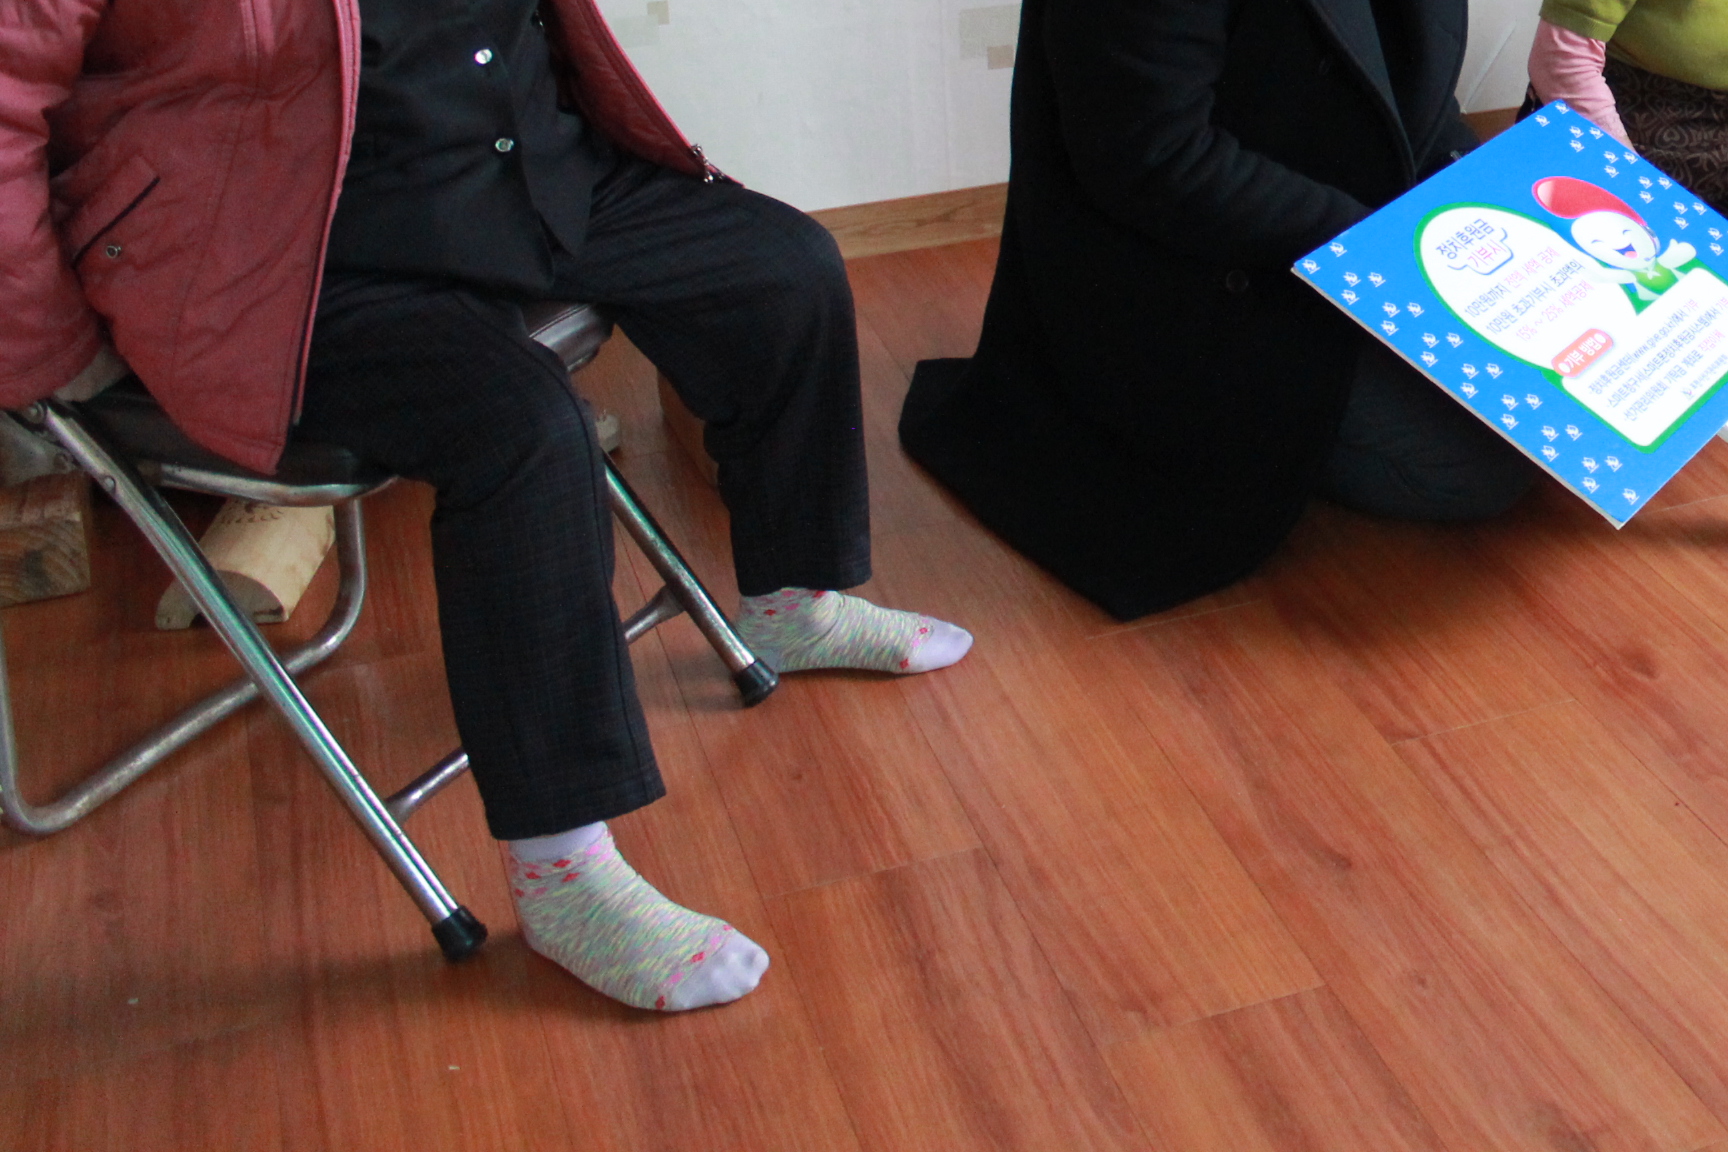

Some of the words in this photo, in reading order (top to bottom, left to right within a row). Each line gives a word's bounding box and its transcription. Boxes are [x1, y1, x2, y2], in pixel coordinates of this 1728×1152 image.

[1433, 216, 1496, 261] 정치후원금
[1463, 238, 1507, 270] 기부시
[1461, 281, 1512, 319] 10만원까지
[1501, 269, 1528, 289] 전액
[1518, 257, 1545, 277] 세액
[1534, 245, 1561, 264] 공제
[1483, 309, 1519, 336] 10만원
[1508, 280, 1556, 317] 초과기부시
[1546, 257, 1585, 288] 초과액의
[1513, 322, 1539, 342] 15%
[1539, 302, 1565, 322] 25%
[1556, 279, 1595, 309] 세액공제
[1681, 297, 1701, 314] 기부
[1561, 348, 1587, 369] 기부
[1577, 336, 1603, 357] 방법
